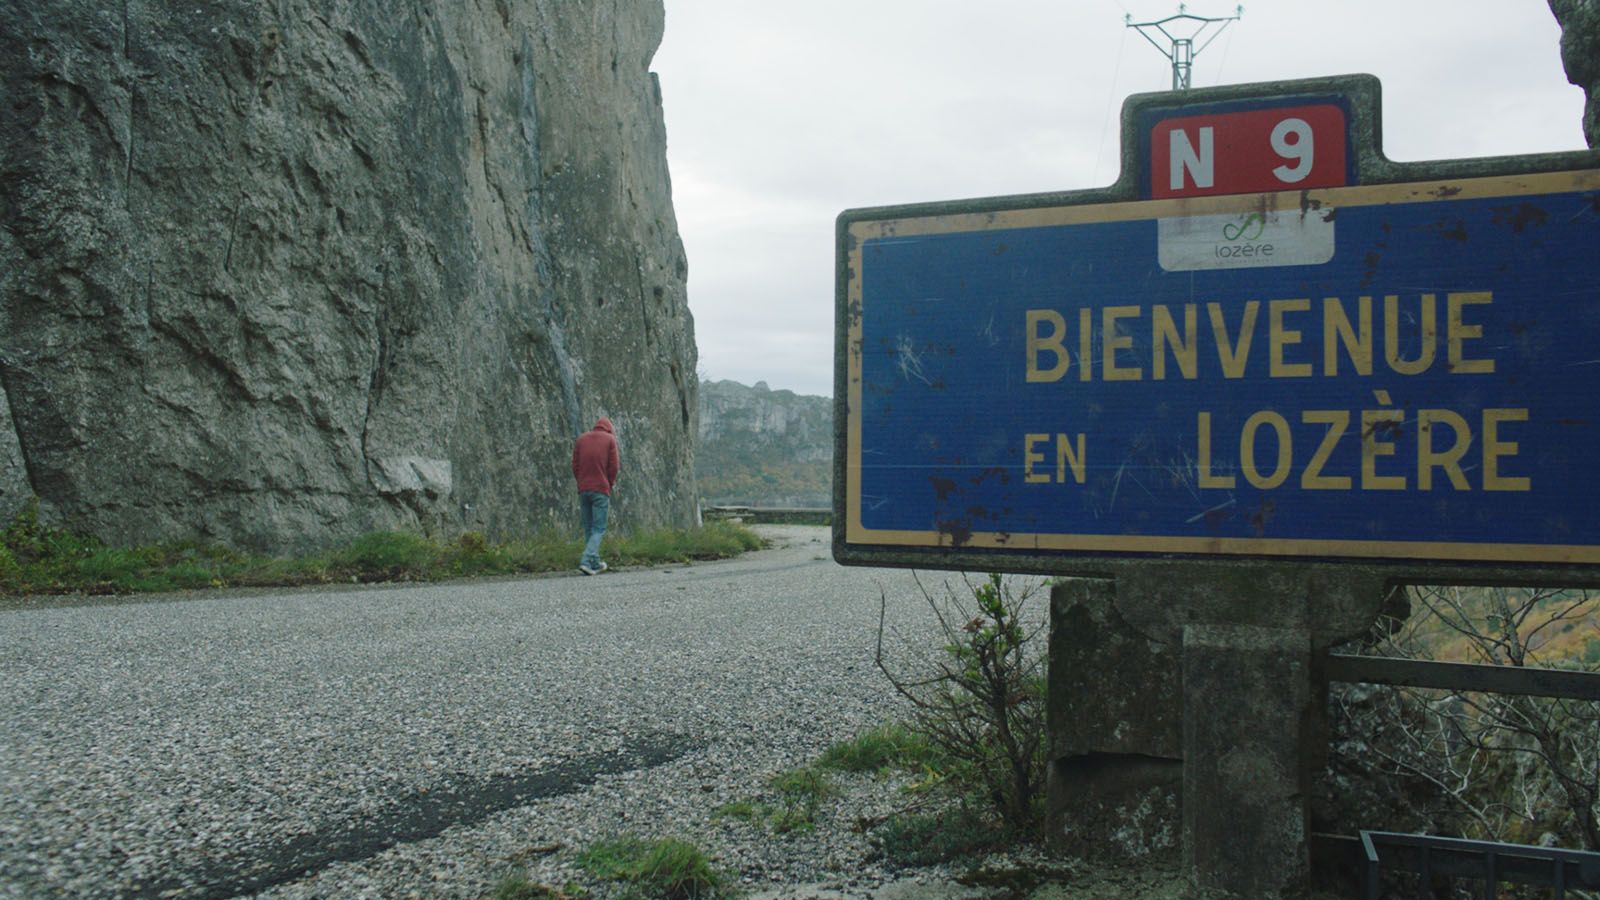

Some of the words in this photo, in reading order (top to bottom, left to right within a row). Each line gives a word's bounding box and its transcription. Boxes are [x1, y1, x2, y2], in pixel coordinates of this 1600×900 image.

[1169, 126, 1214, 190] N
[1270, 118, 1315, 183] 9
[1024, 291, 1496, 383] BIENVENUE
[1023, 433, 1086, 484] EN
[1197, 389, 1532, 492] LOZÈRE
